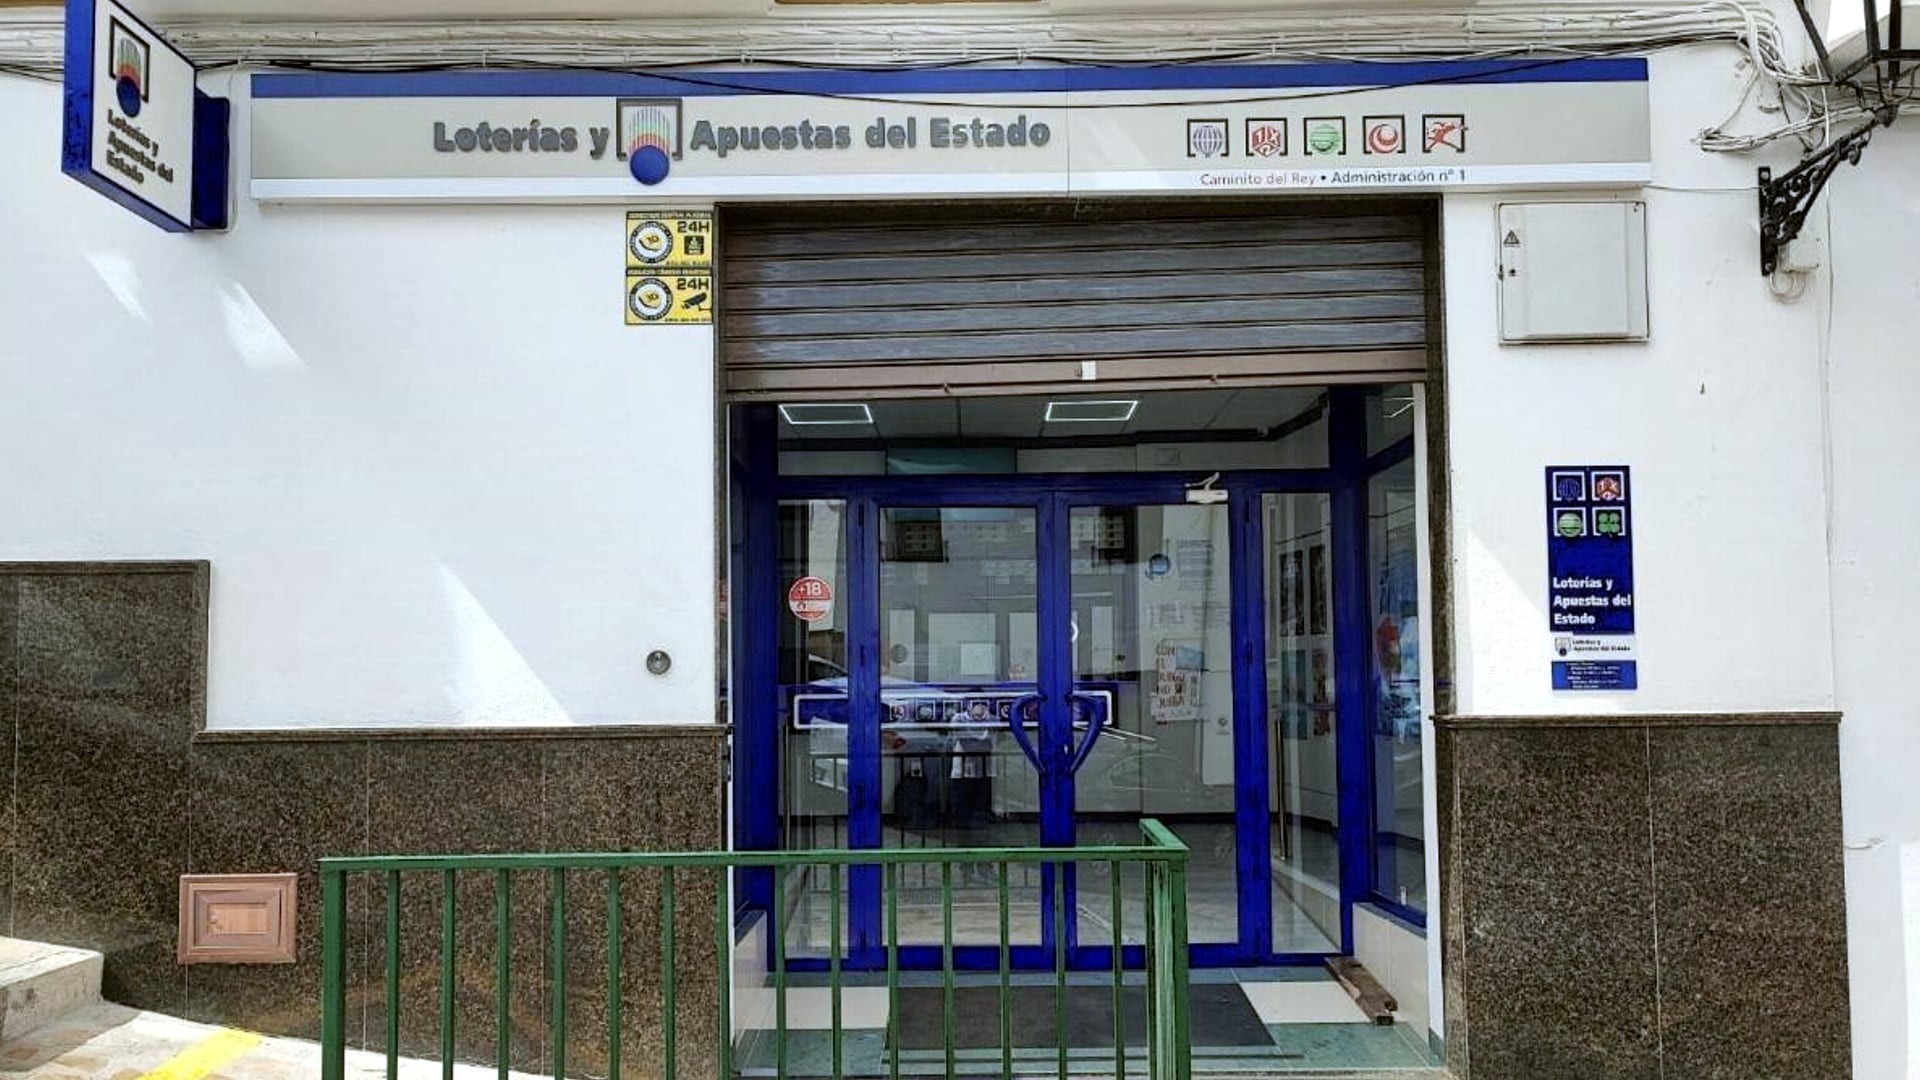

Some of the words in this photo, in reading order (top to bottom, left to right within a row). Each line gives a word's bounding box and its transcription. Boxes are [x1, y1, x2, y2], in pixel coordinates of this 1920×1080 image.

[433, 119, 578, 153] Loterías
[589, 127, 609, 160] y
[690, 119, 851, 158] Apuestas
[865, 116, 916, 149] del
[930, 115, 1051, 148] Estado
[108, 130, 155, 172] Apuestas
[158, 163, 173, 183] del
[106, 149, 144, 184] Estado
[1200, 171, 1263, 186] Caminito
[1266, 172, 1287, 185] del
[1291, 172, 1317, 186] Rey
[1331, 169, 1435, 184] Administración
[1459, 168, 1466, 181] 1
[677, 221, 710, 233] 24H
[677, 278, 710, 290] 24H
[1553, 576, 1602, 589] Loterías
[1606, 579, 1613, 591] y
[1553, 595, 1609, 609] Apuestas
[1612, 594, 1632, 606] del
[1554, 612, 1595, 624] Estado
